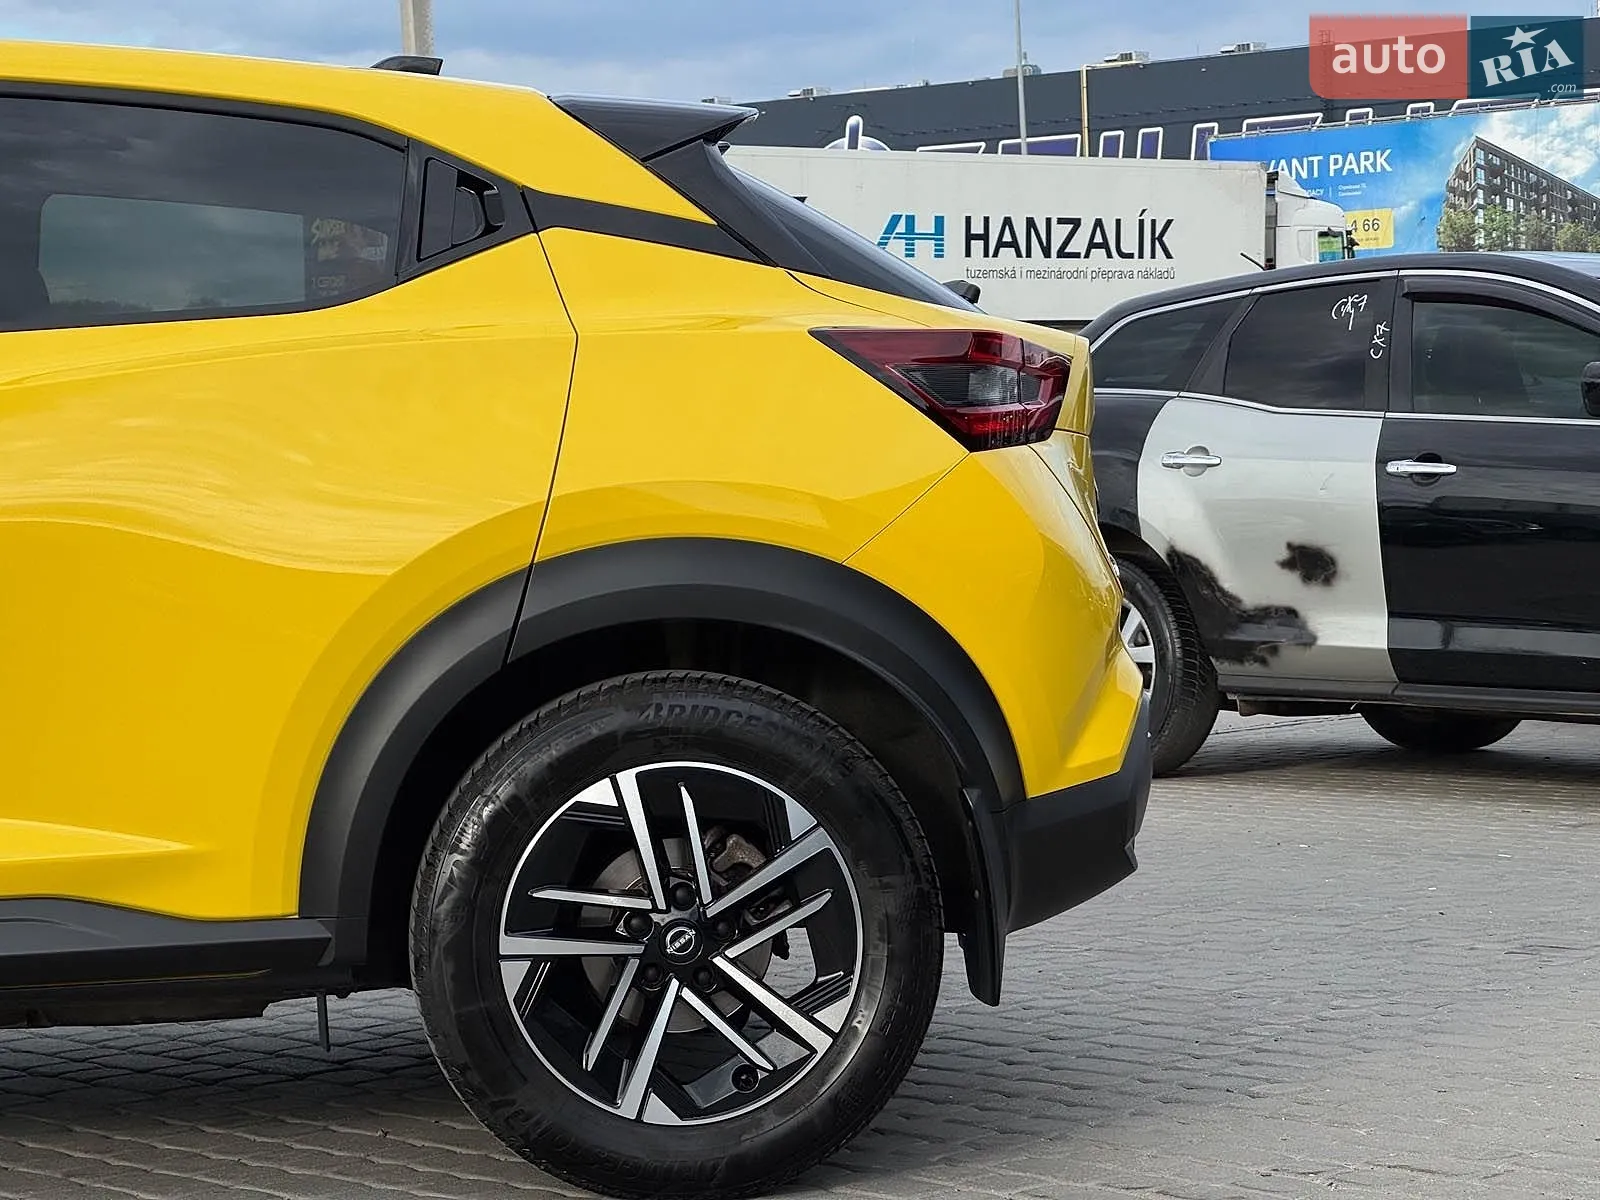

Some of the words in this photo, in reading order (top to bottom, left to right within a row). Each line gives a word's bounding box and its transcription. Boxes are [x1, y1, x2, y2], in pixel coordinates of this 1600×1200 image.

[1329, 149, 1393, 177] PARK
[964, 208, 1175, 260] HANZALÍK
[1363, 218, 1380, 231] 66
[966, 266, 1017, 280] tuzemská
[1026, 266, 1088, 280] mezinárodní
[1091, 267, 1134, 283] přeprava
[1137, 267, 1175, 281] nákladů
[1370, 321, 1391, 359] CX7
